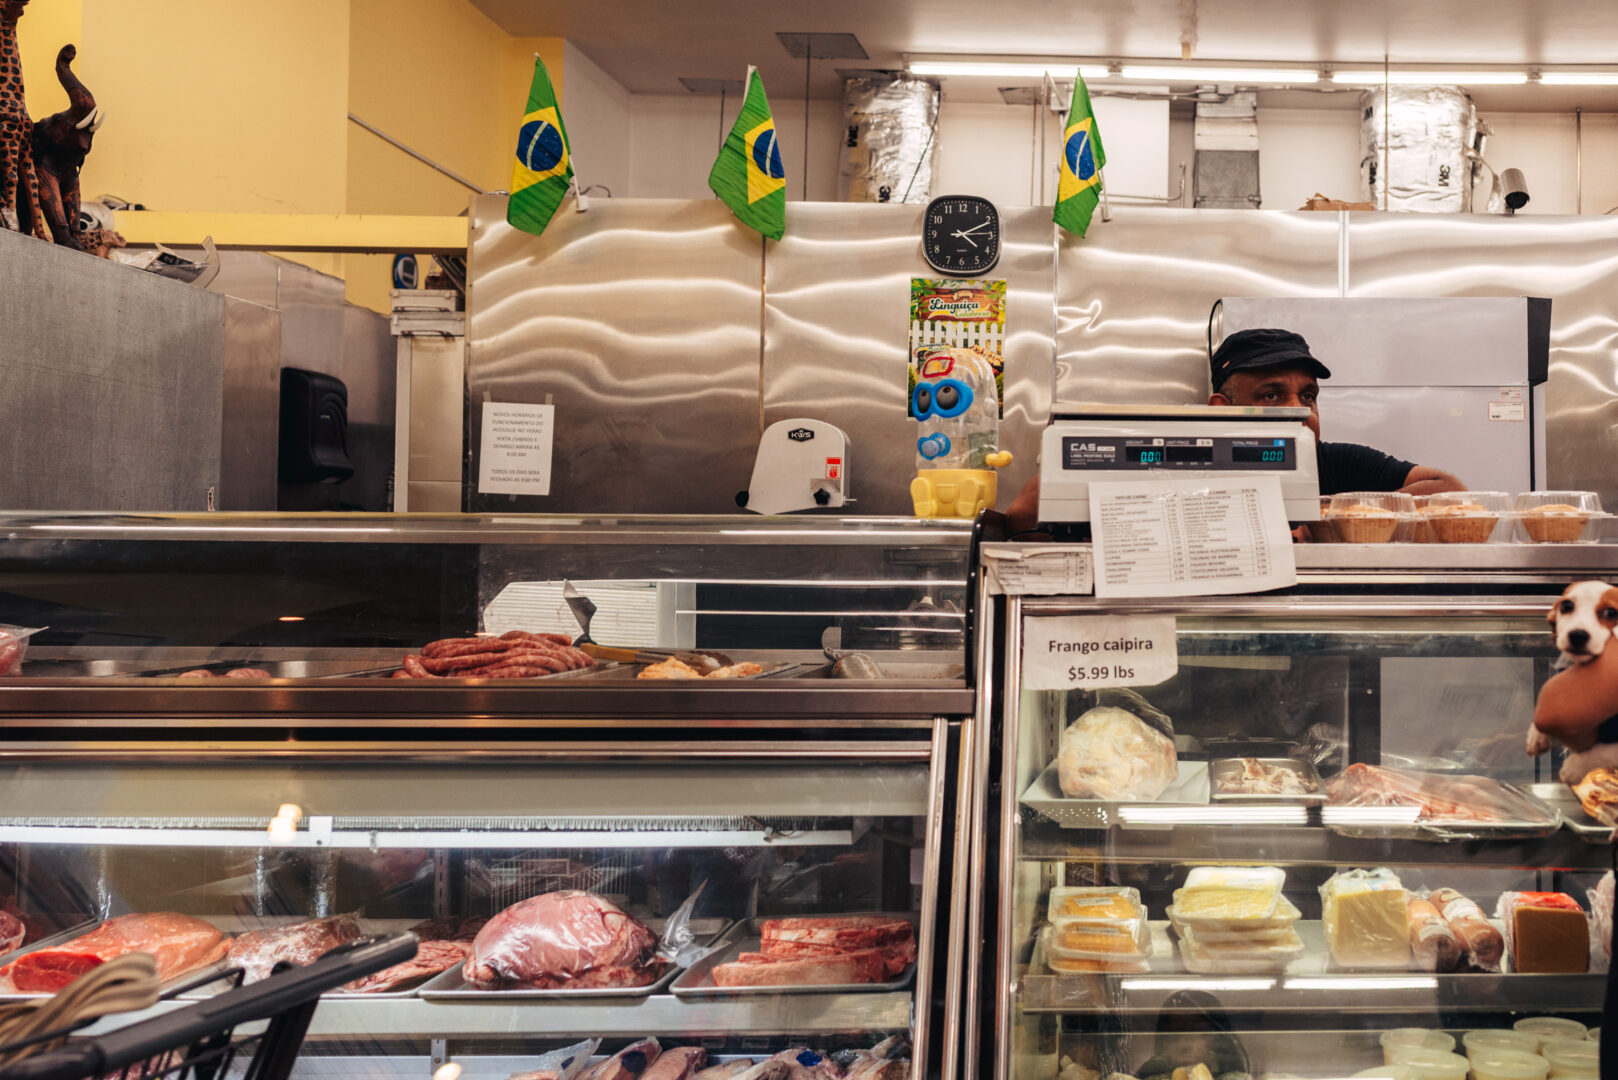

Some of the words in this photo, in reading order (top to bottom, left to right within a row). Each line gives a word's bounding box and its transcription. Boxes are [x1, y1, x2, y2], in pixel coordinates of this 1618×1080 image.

[847, 125, 859, 147] 3M
[1438, 165, 1450, 187] 3M
[944, 204, 952, 214] 11
[959, 204, 968, 212] 12
[975, 205, 979, 214] 1
[934, 216, 942, 224] 10
[986, 216, 991, 224] 2
[932, 230, 937, 239] 9
[988, 231, 993, 240] 3
[935, 245, 940, 253] 8
[985, 247, 990, 255] 4
[946, 256, 950, 264] 7
[959, 257, 964, 265] 6
[974, 256, 979, 264] 5
[930, 298, 979, 313] Linguiça
[1070, 443, 1096, 451] CAS
[1049, 640, 1099, 654] Frango
[1104, 638, 1153, 652] caipira
[1068, 665, 1109, 682] $5.99
[1114, 666, 1134, 678] lbs
